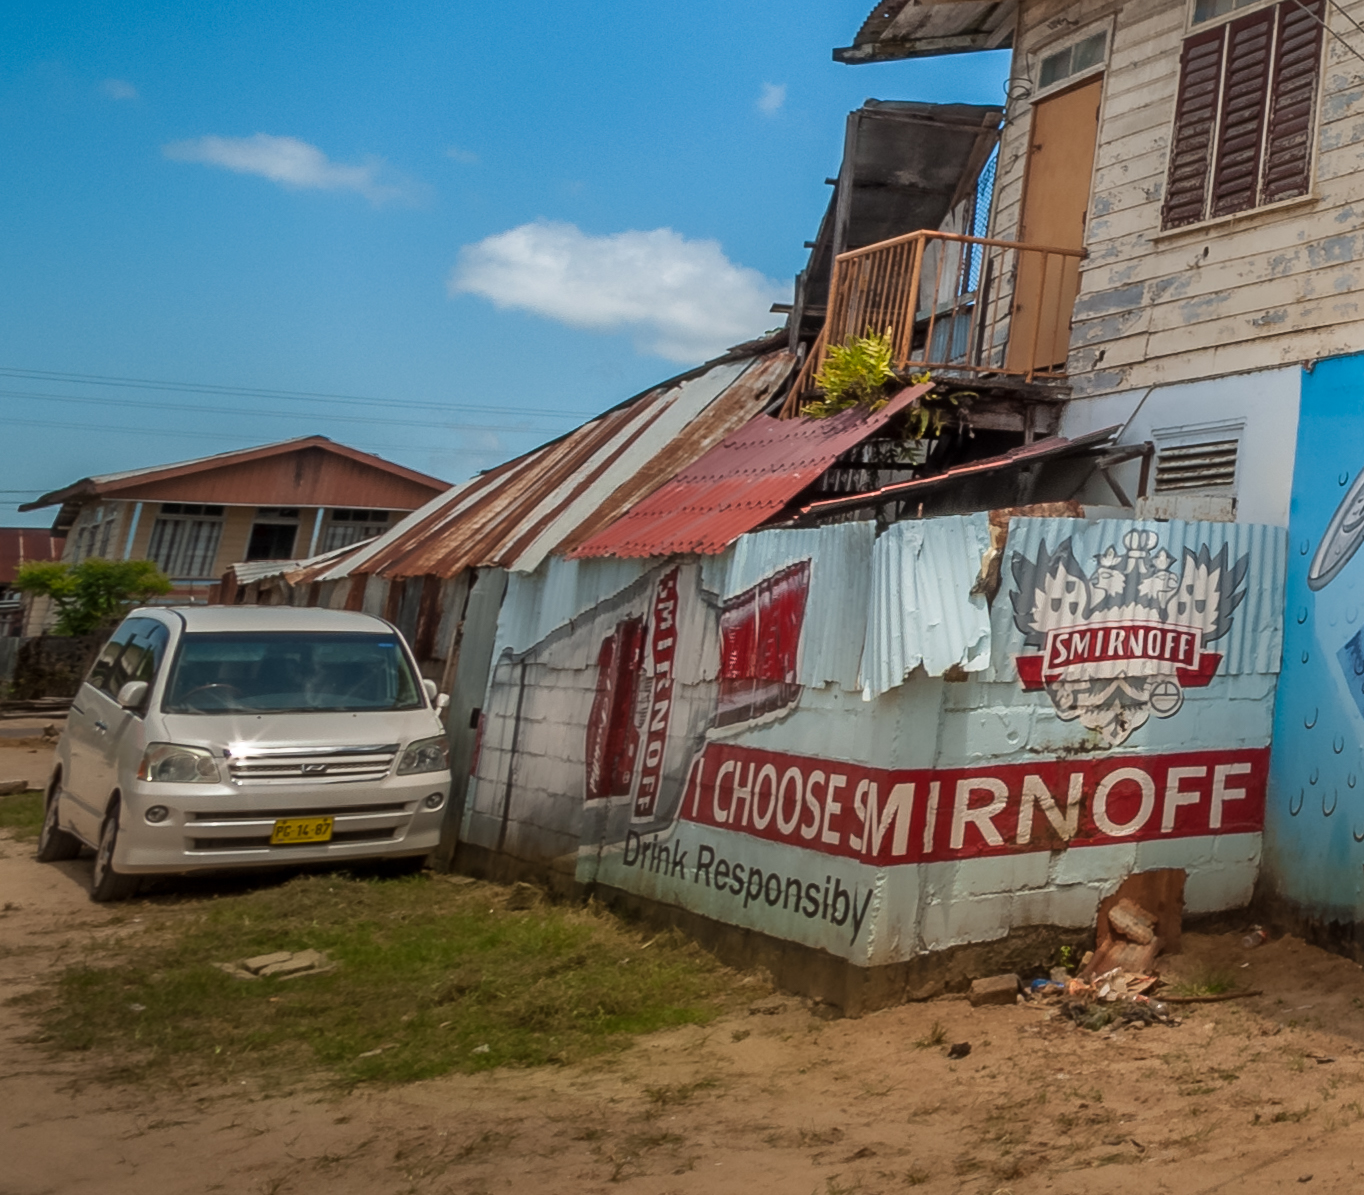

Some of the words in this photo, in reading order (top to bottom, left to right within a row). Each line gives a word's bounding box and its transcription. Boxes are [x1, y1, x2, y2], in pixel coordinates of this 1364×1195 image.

[1053, 628, 1192, 664] SMIRNOFF
[691, 757, 705, 817] I
[713, 759, 848, 845] CHOOSE
[849, 761, 1252, 856] SMIRNOFF
[622, 829, 688, 881] Drink
[694, 844, 874, 947] Responsiby
